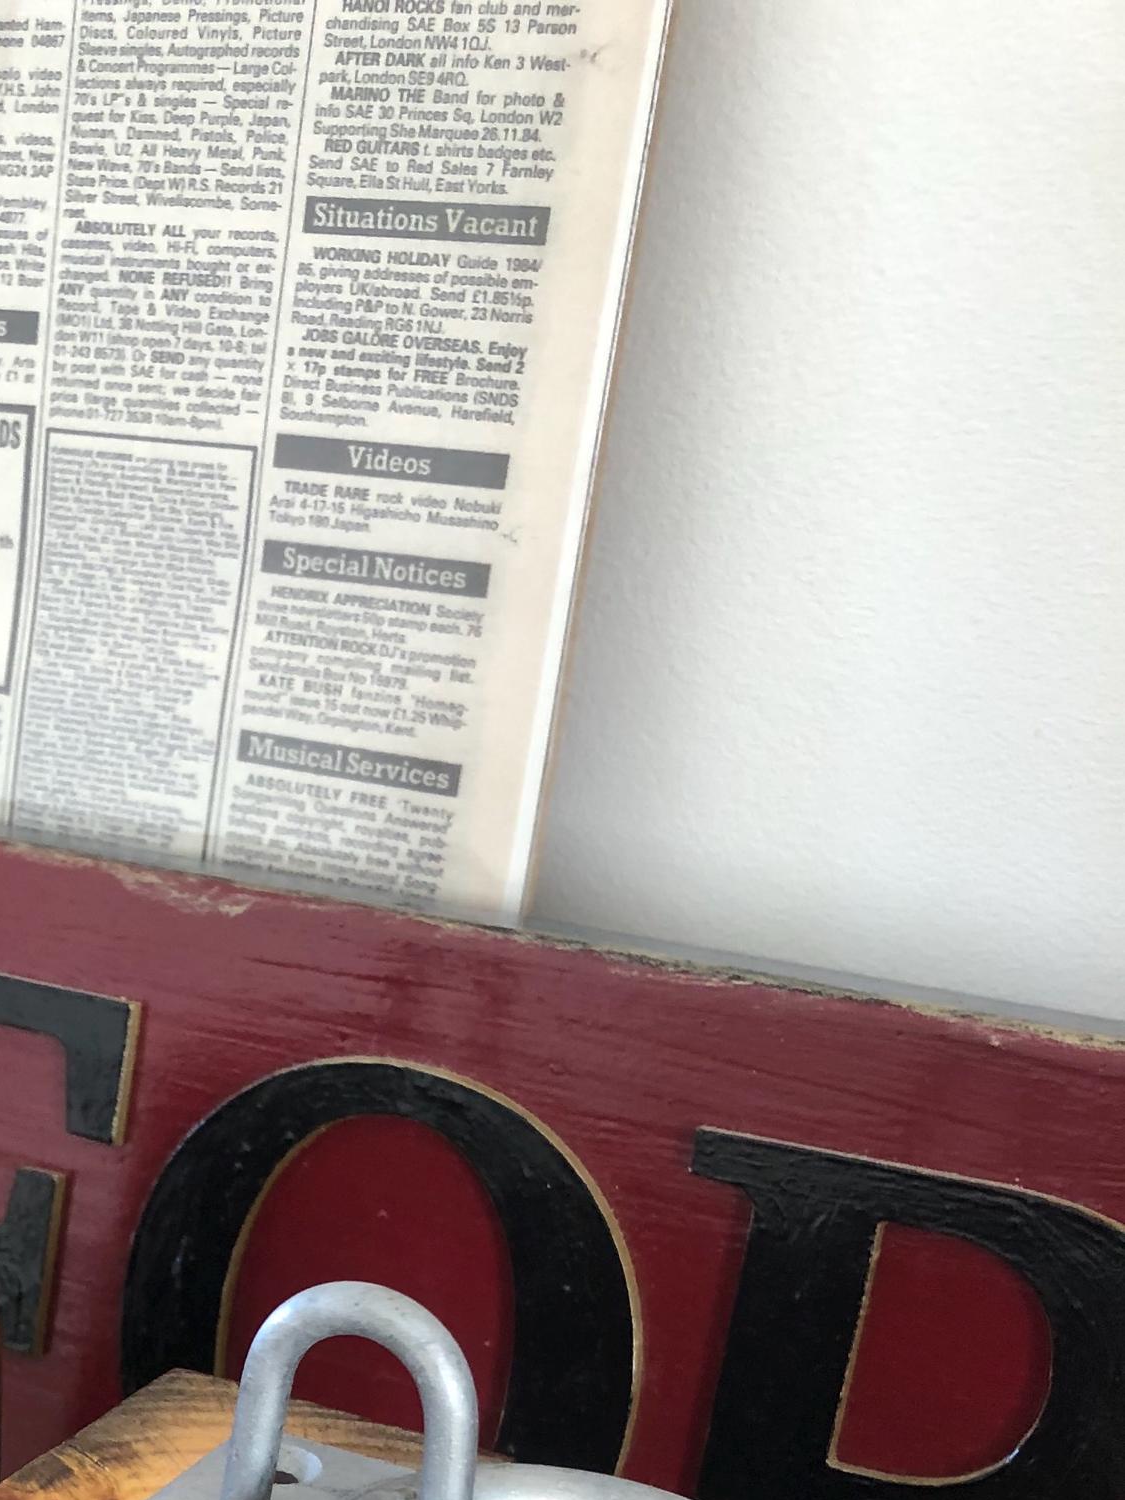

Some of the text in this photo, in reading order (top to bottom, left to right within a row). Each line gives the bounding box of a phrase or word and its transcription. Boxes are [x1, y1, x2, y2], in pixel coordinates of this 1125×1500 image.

[259, 10, 304, 23] Picture
[395, 0, 444, 14] ROCKS
[451, 2, 471, 14] fan
[479, 2, 507, 15] club
[514, 4, 539, 16] and
[253, 28, 301, 41] Picture
[326, 18, 399, 34] chandising
[407, 19, 435, 31] SAE
[444, 20, 469, 32] Box
[505, 20, 519, 33] 13
[371, 34, 421, 49] London
[335, 52, 380, 66] AFTER
[385, 53, 425, 67] DARK
[453, 55, 478, 69] info
[484, 56, 510, 70] Ken
[517, 57, 524, 69] 3
[355, 70, 405, 84] London
[399, 89, 425, 102] THE
[433, 90, 468, 104] Band
[477, 91, 494, 104] for
[504, 92, 545, 108] photo
[346, 105, 373, 118] SAE
[481, 110, 533, 124] London
[539, 112, 563, 125] W2
[390, 124, 417, 138] She
[325, 139, 352, 153] RED
[357, 140, 419, 156] GUITARS
[477, 146, 527, 161] badges
[309, 156, 342, 170] Send
[351, 158, 377, 171] SAE
[407, 160, 433, 174] Red
[314, 202, 537, 237] Situations Vacant
[313, 247, 381, 263] WORKING
[387, 250, 451, 267] HOLIDAY
[431, 287, 465, 302] Send
[476, 358, 511, 373] Send
[515, 360, 524, 374] 2
[414, 370, 448, 385] FREE
[348, 445, 431, 475] Videos
[283, 547, 467, 589] Special Notices
[248, 735, 449, 789] Musical Services
